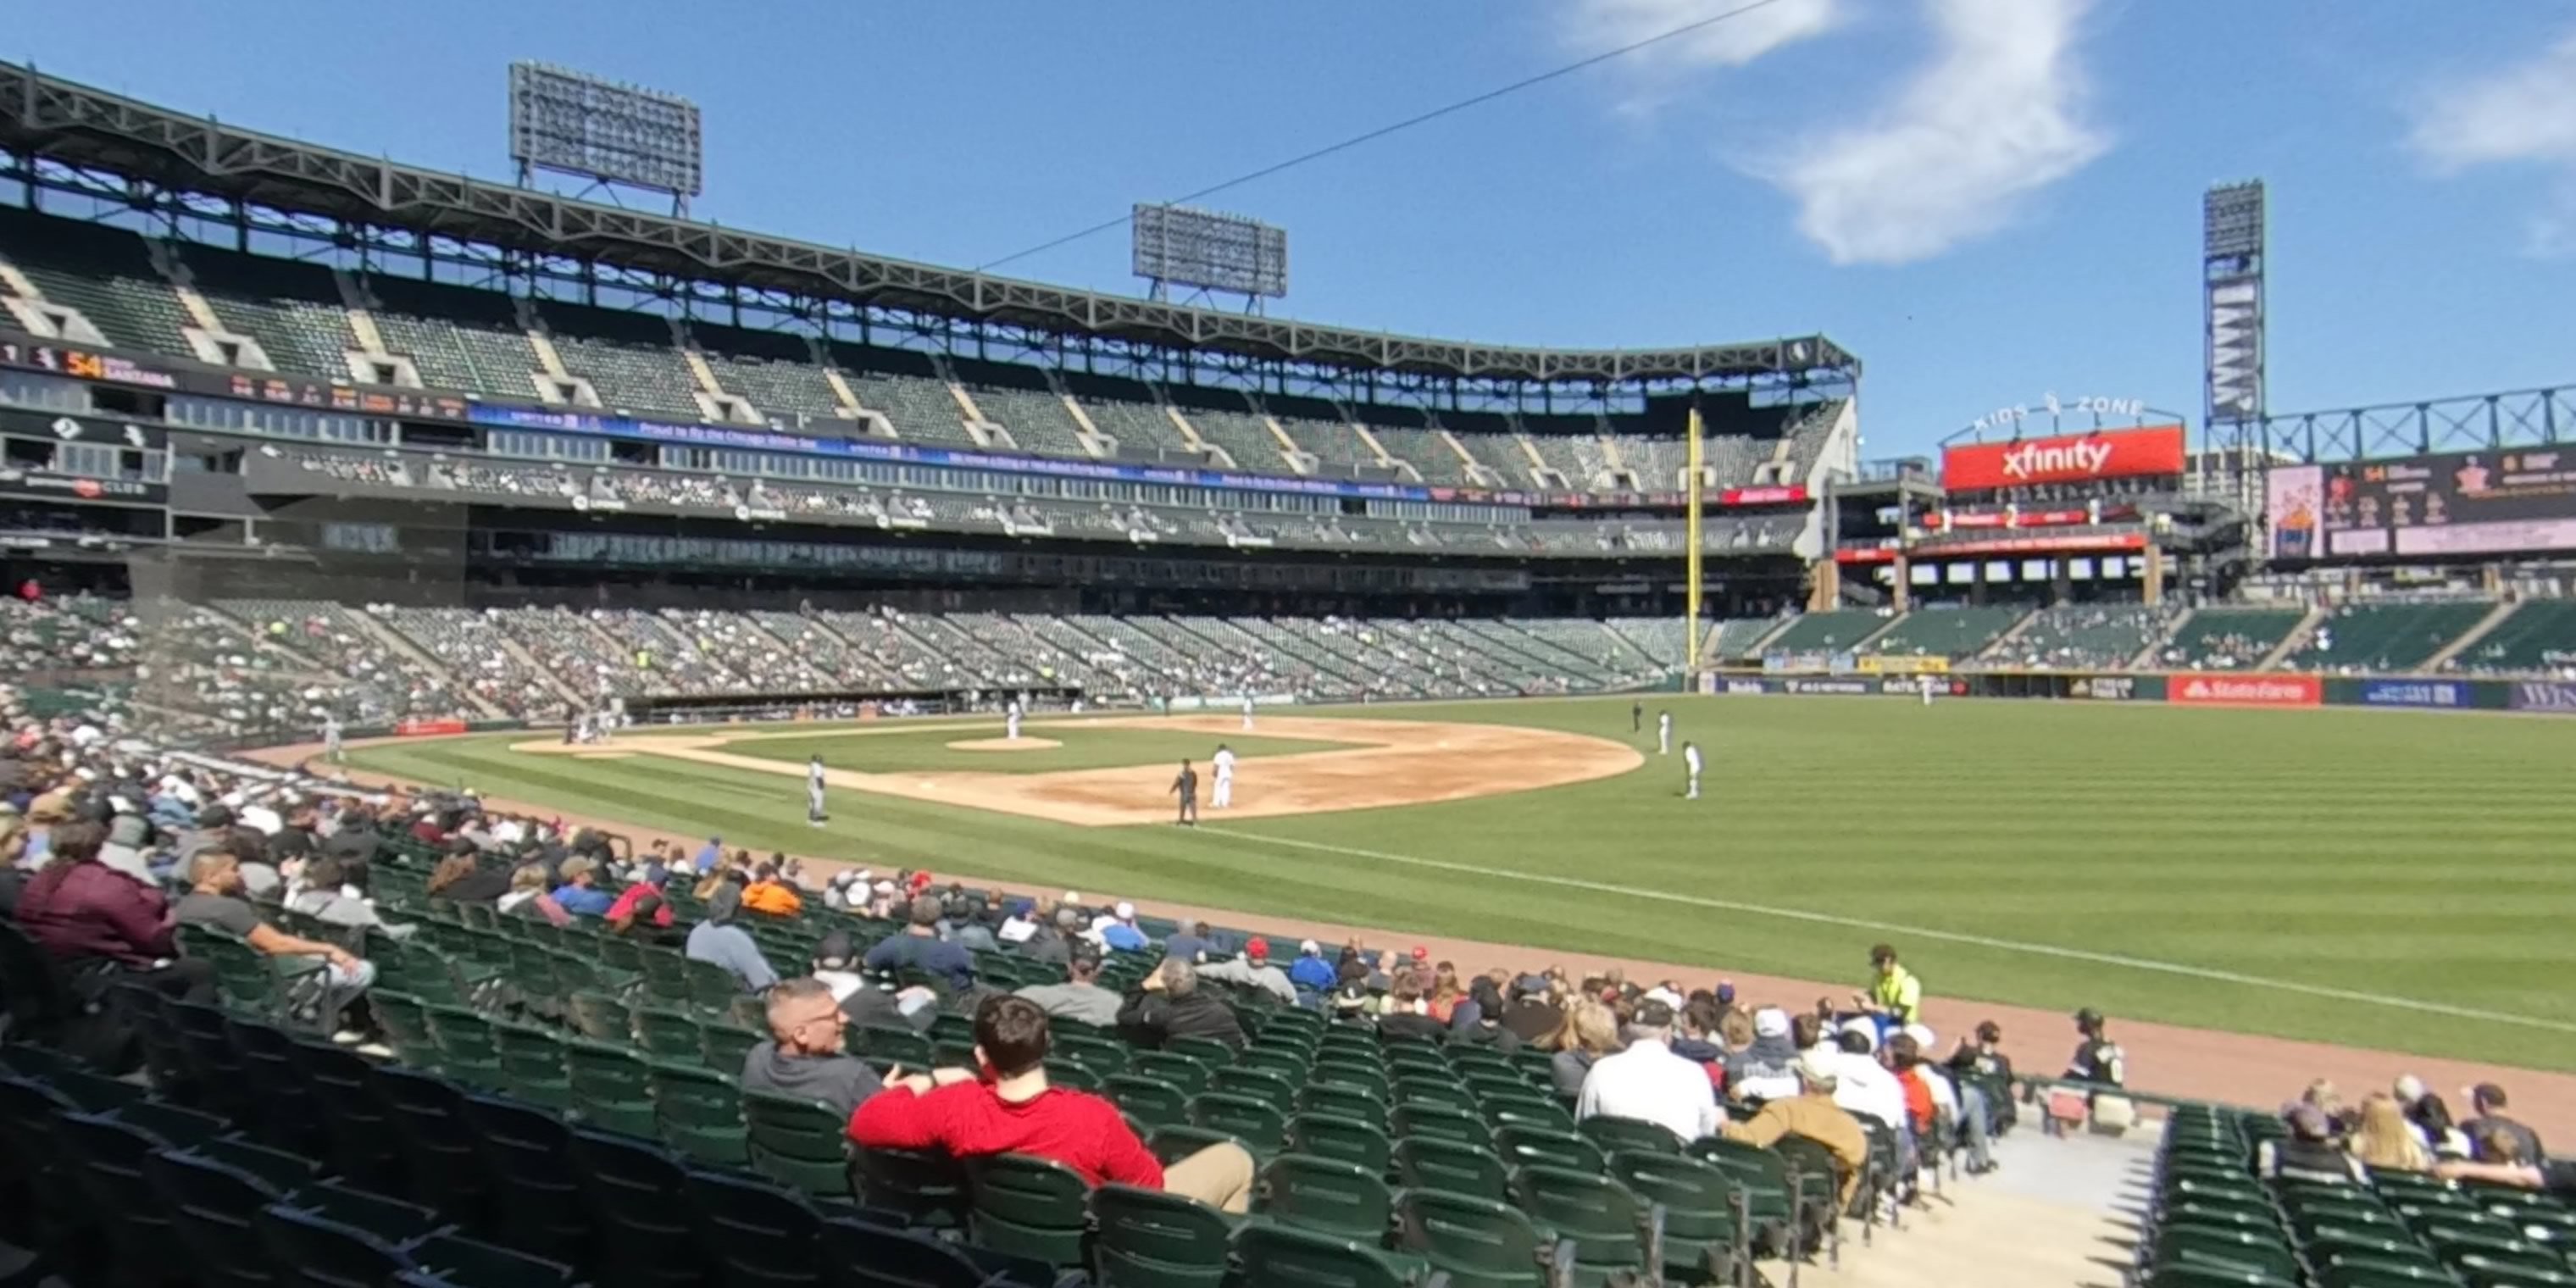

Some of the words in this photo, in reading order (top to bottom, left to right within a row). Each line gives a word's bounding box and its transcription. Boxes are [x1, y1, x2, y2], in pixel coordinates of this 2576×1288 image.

[67, 351, 103, 379] 54
[103, 366, 175, 388] SANTANA
[1973, 402, 2029, 430] KIDS
[2077, 396, 2145, 416] ZONE
[640, 422, 673, 437] Proud
[2001, 439, 2113, 480] xfinity
[102, 480, 147, 495] CLUB
[2211, 680, 2257, 697] State
[2257, 681, 2305, 699] Farm
